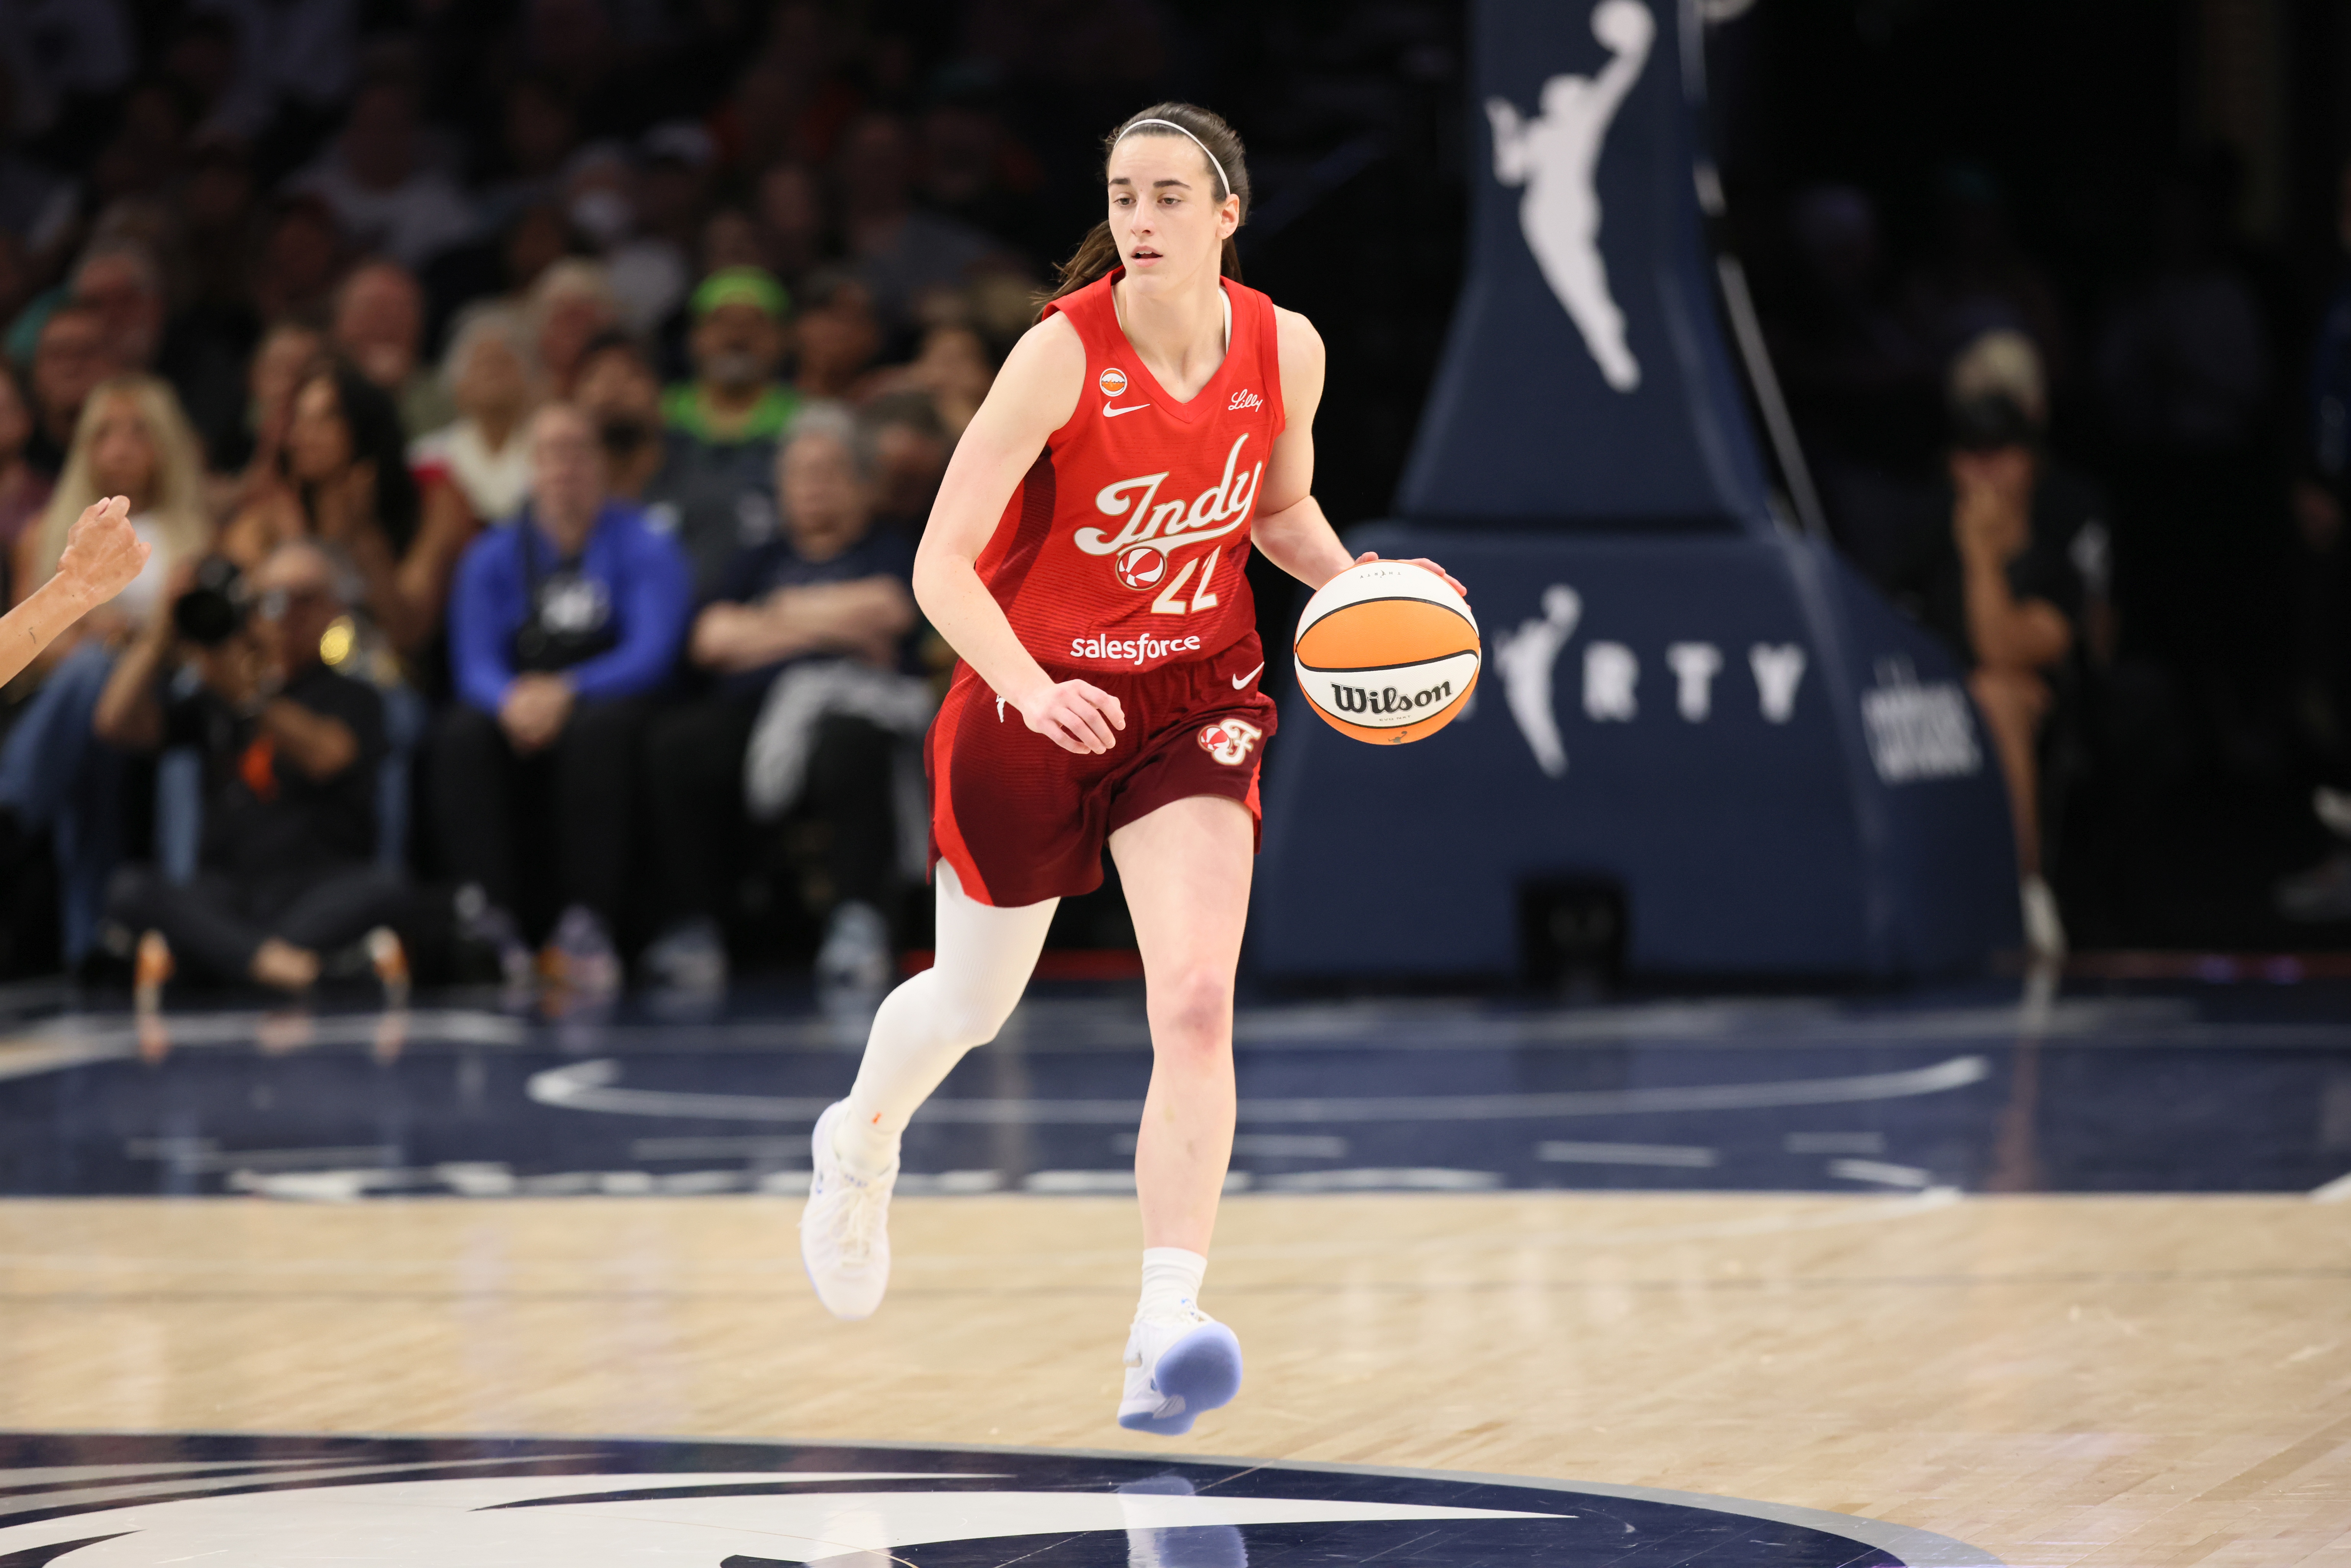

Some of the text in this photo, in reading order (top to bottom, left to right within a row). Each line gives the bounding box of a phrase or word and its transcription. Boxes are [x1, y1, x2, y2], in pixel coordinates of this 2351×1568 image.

[1228, 389, 1263, 412] Lilly
[1074, 432, 1262, 556] Indy
[1070, 633, 1200, 665] salesforce
[1330, 680, 1453, 714] Wilson
